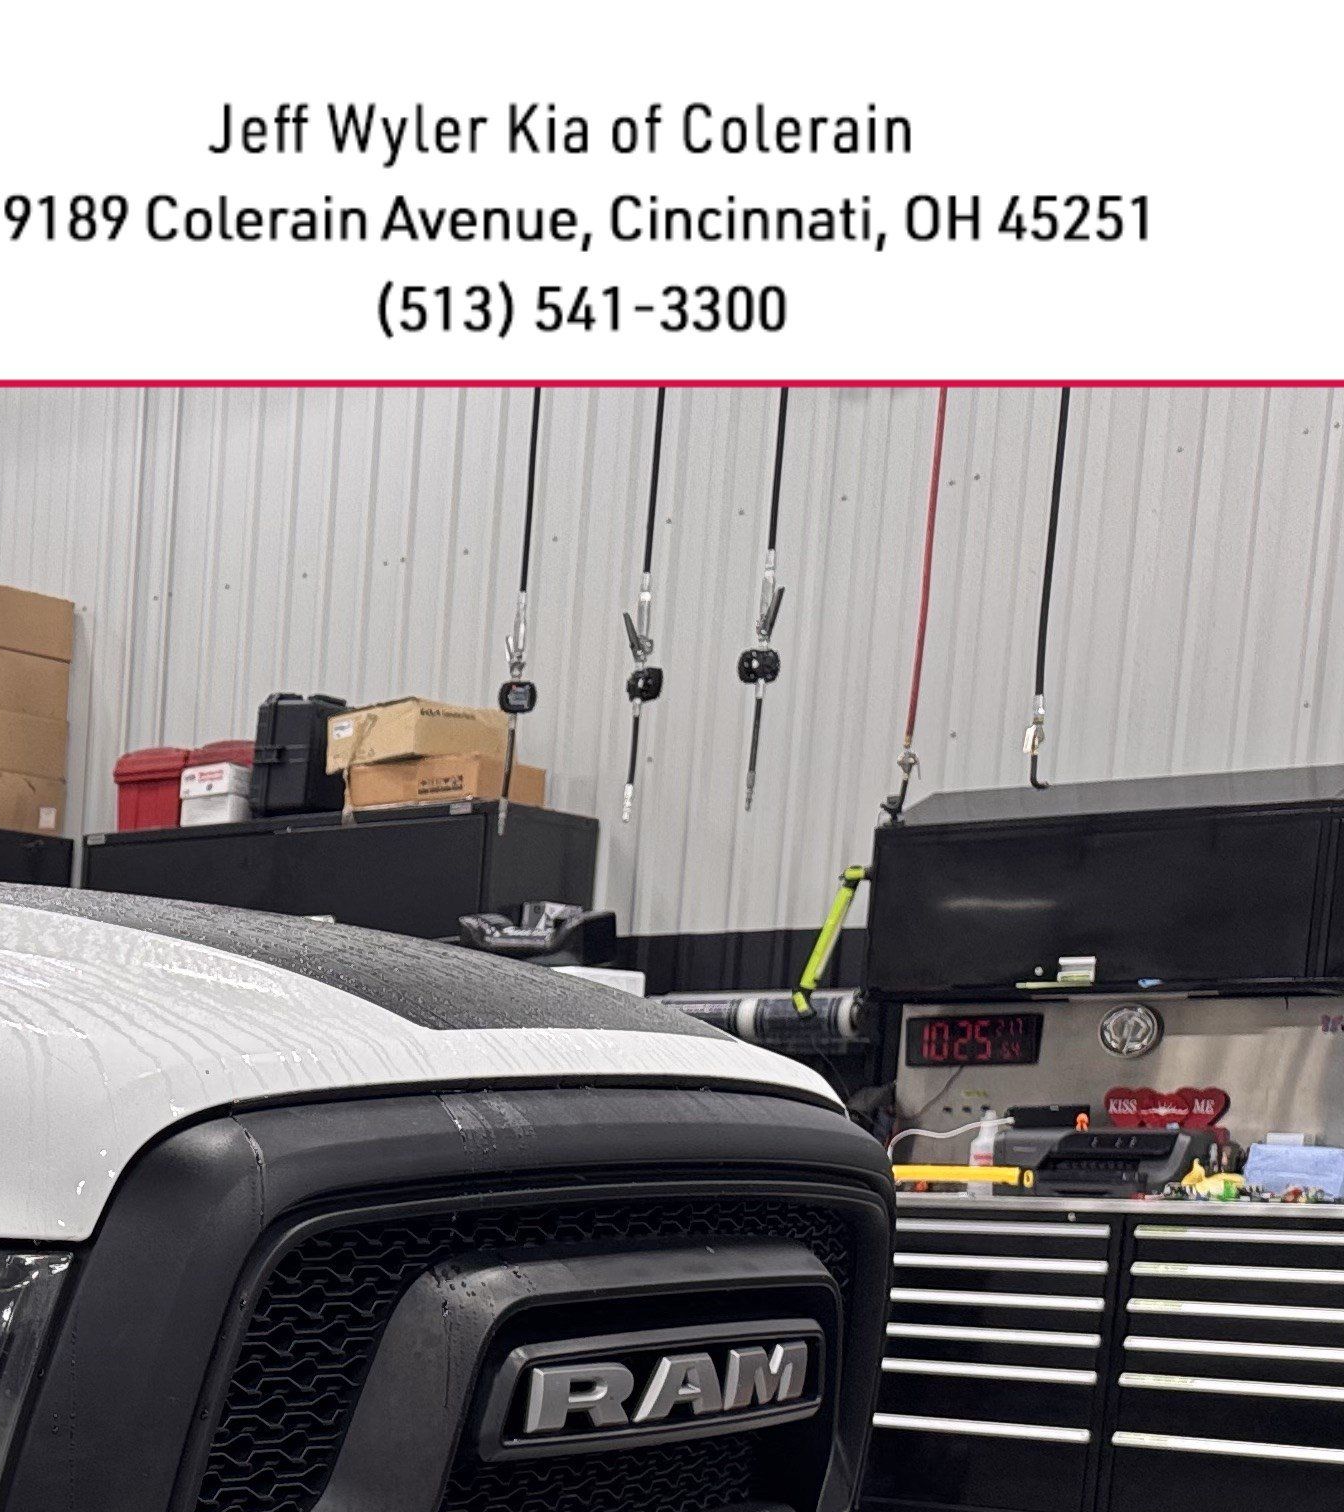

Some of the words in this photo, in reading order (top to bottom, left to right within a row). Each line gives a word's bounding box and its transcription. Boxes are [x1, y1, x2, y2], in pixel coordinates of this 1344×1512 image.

[1108, 1099, 1138, 1114] KISS
[1193, 1099, 1215, 1115] ME
[523, 1340, 809, 1434] RAM
